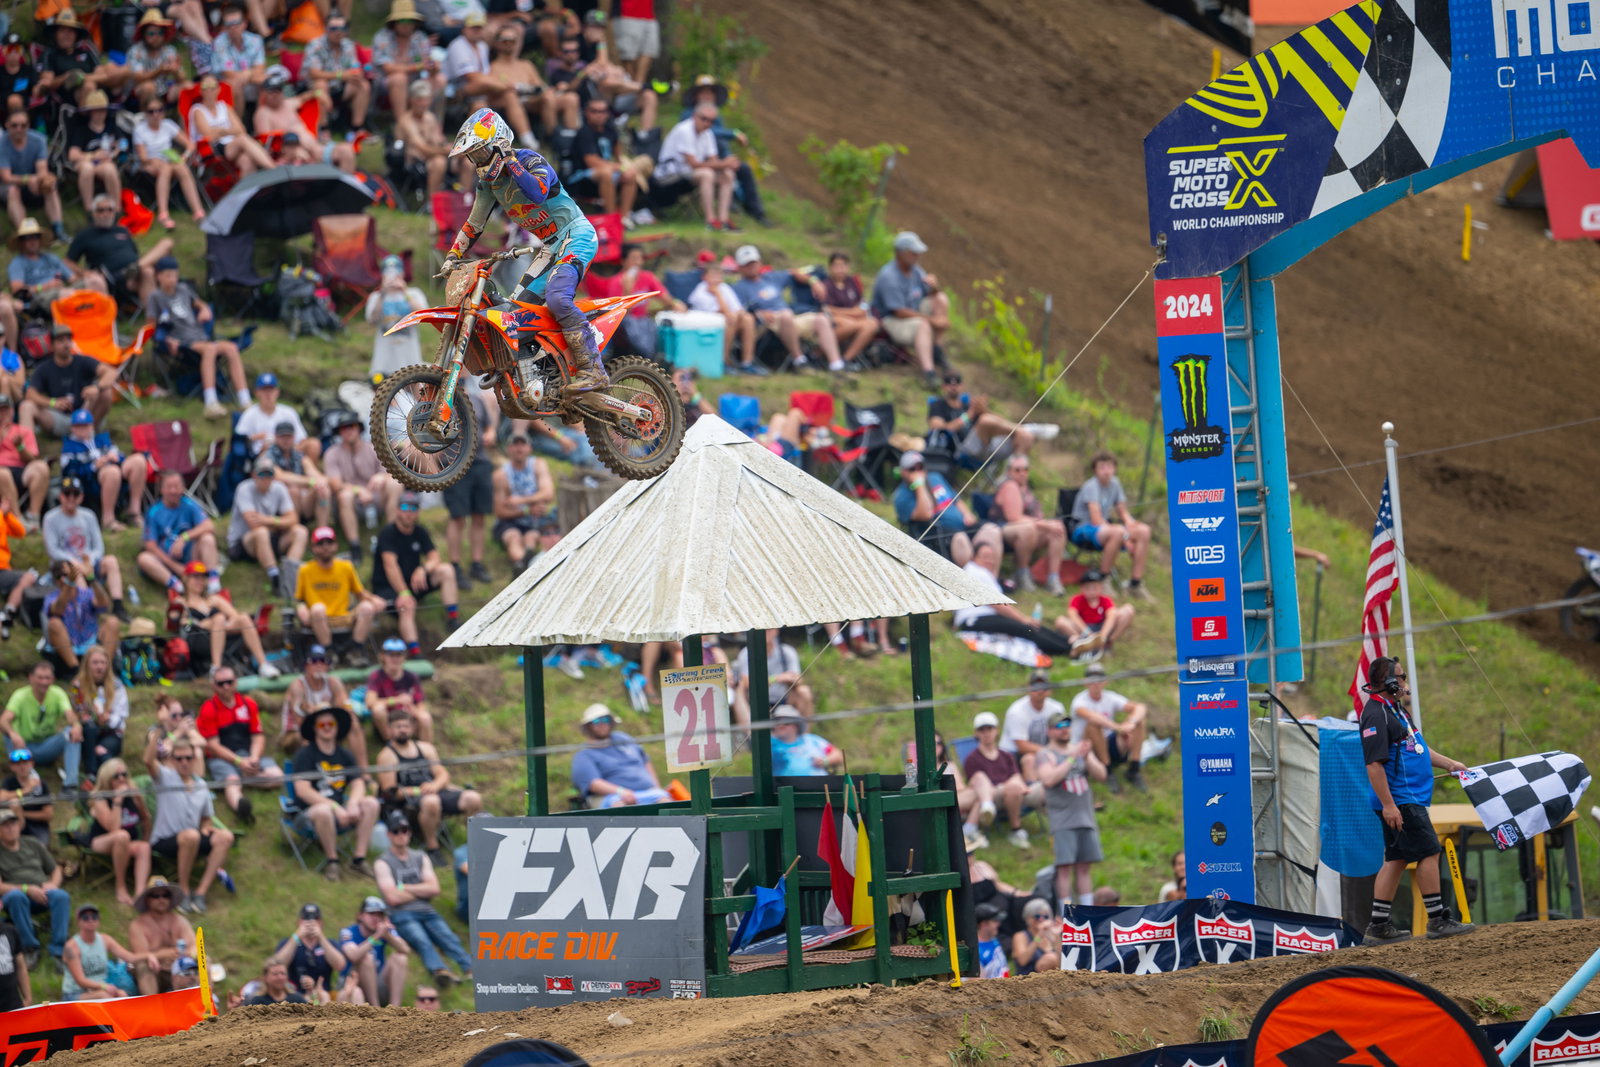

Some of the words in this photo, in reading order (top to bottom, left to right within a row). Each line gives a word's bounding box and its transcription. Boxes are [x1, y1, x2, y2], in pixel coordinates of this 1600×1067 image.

[1497, 60, 1597, 88] CHA
[1168, 156, 1232, 176] SUPER
[1173, 173, 1229, 193] MOTO
[1169, 190, 1231, 210] CROSS
[528, 210, 550, 226] Bull
[1173, 218, 1208, 231] WORLD
[1209, 212, 1285, 229] CHAMPIONSHIP
[1166, 294, 1213, 319] 2024
[1173, 433, 1221, 447] MONSTER
[1181, 446, 1214, 454] ENERGY
[1180, 516, 1225, 529] FLY
[1185, 545, 1225, 565] WPS
[1196, 584, 1219, 596] KTM
[672, 670, 698, 679] Spring
[1199, 661, 1235, 672] Husqvarna
[673, 687, 721, 764] 21
[1194, 726, 1235, 737] NAMURA
[1208, 758, 1233, 769] YAMAHA
[477, 827, 700, 920] FXR
[1207, 862, 1242, 873] SUZUKI
[1062, 932, 1088, 942] CER
[1116, 928, 1172, 942] RACER
[1278, 935, 1333, 951] RACER
[477, 932, 559, 960] RACE
[564, 932, 619, 960] DIV.
[1134, 943, 1163, 975] X
[476, 983, 489, 996] Shop
[498, 983, 517, 993] Premier
[1537, 1043, 1600, 1060] RACER
